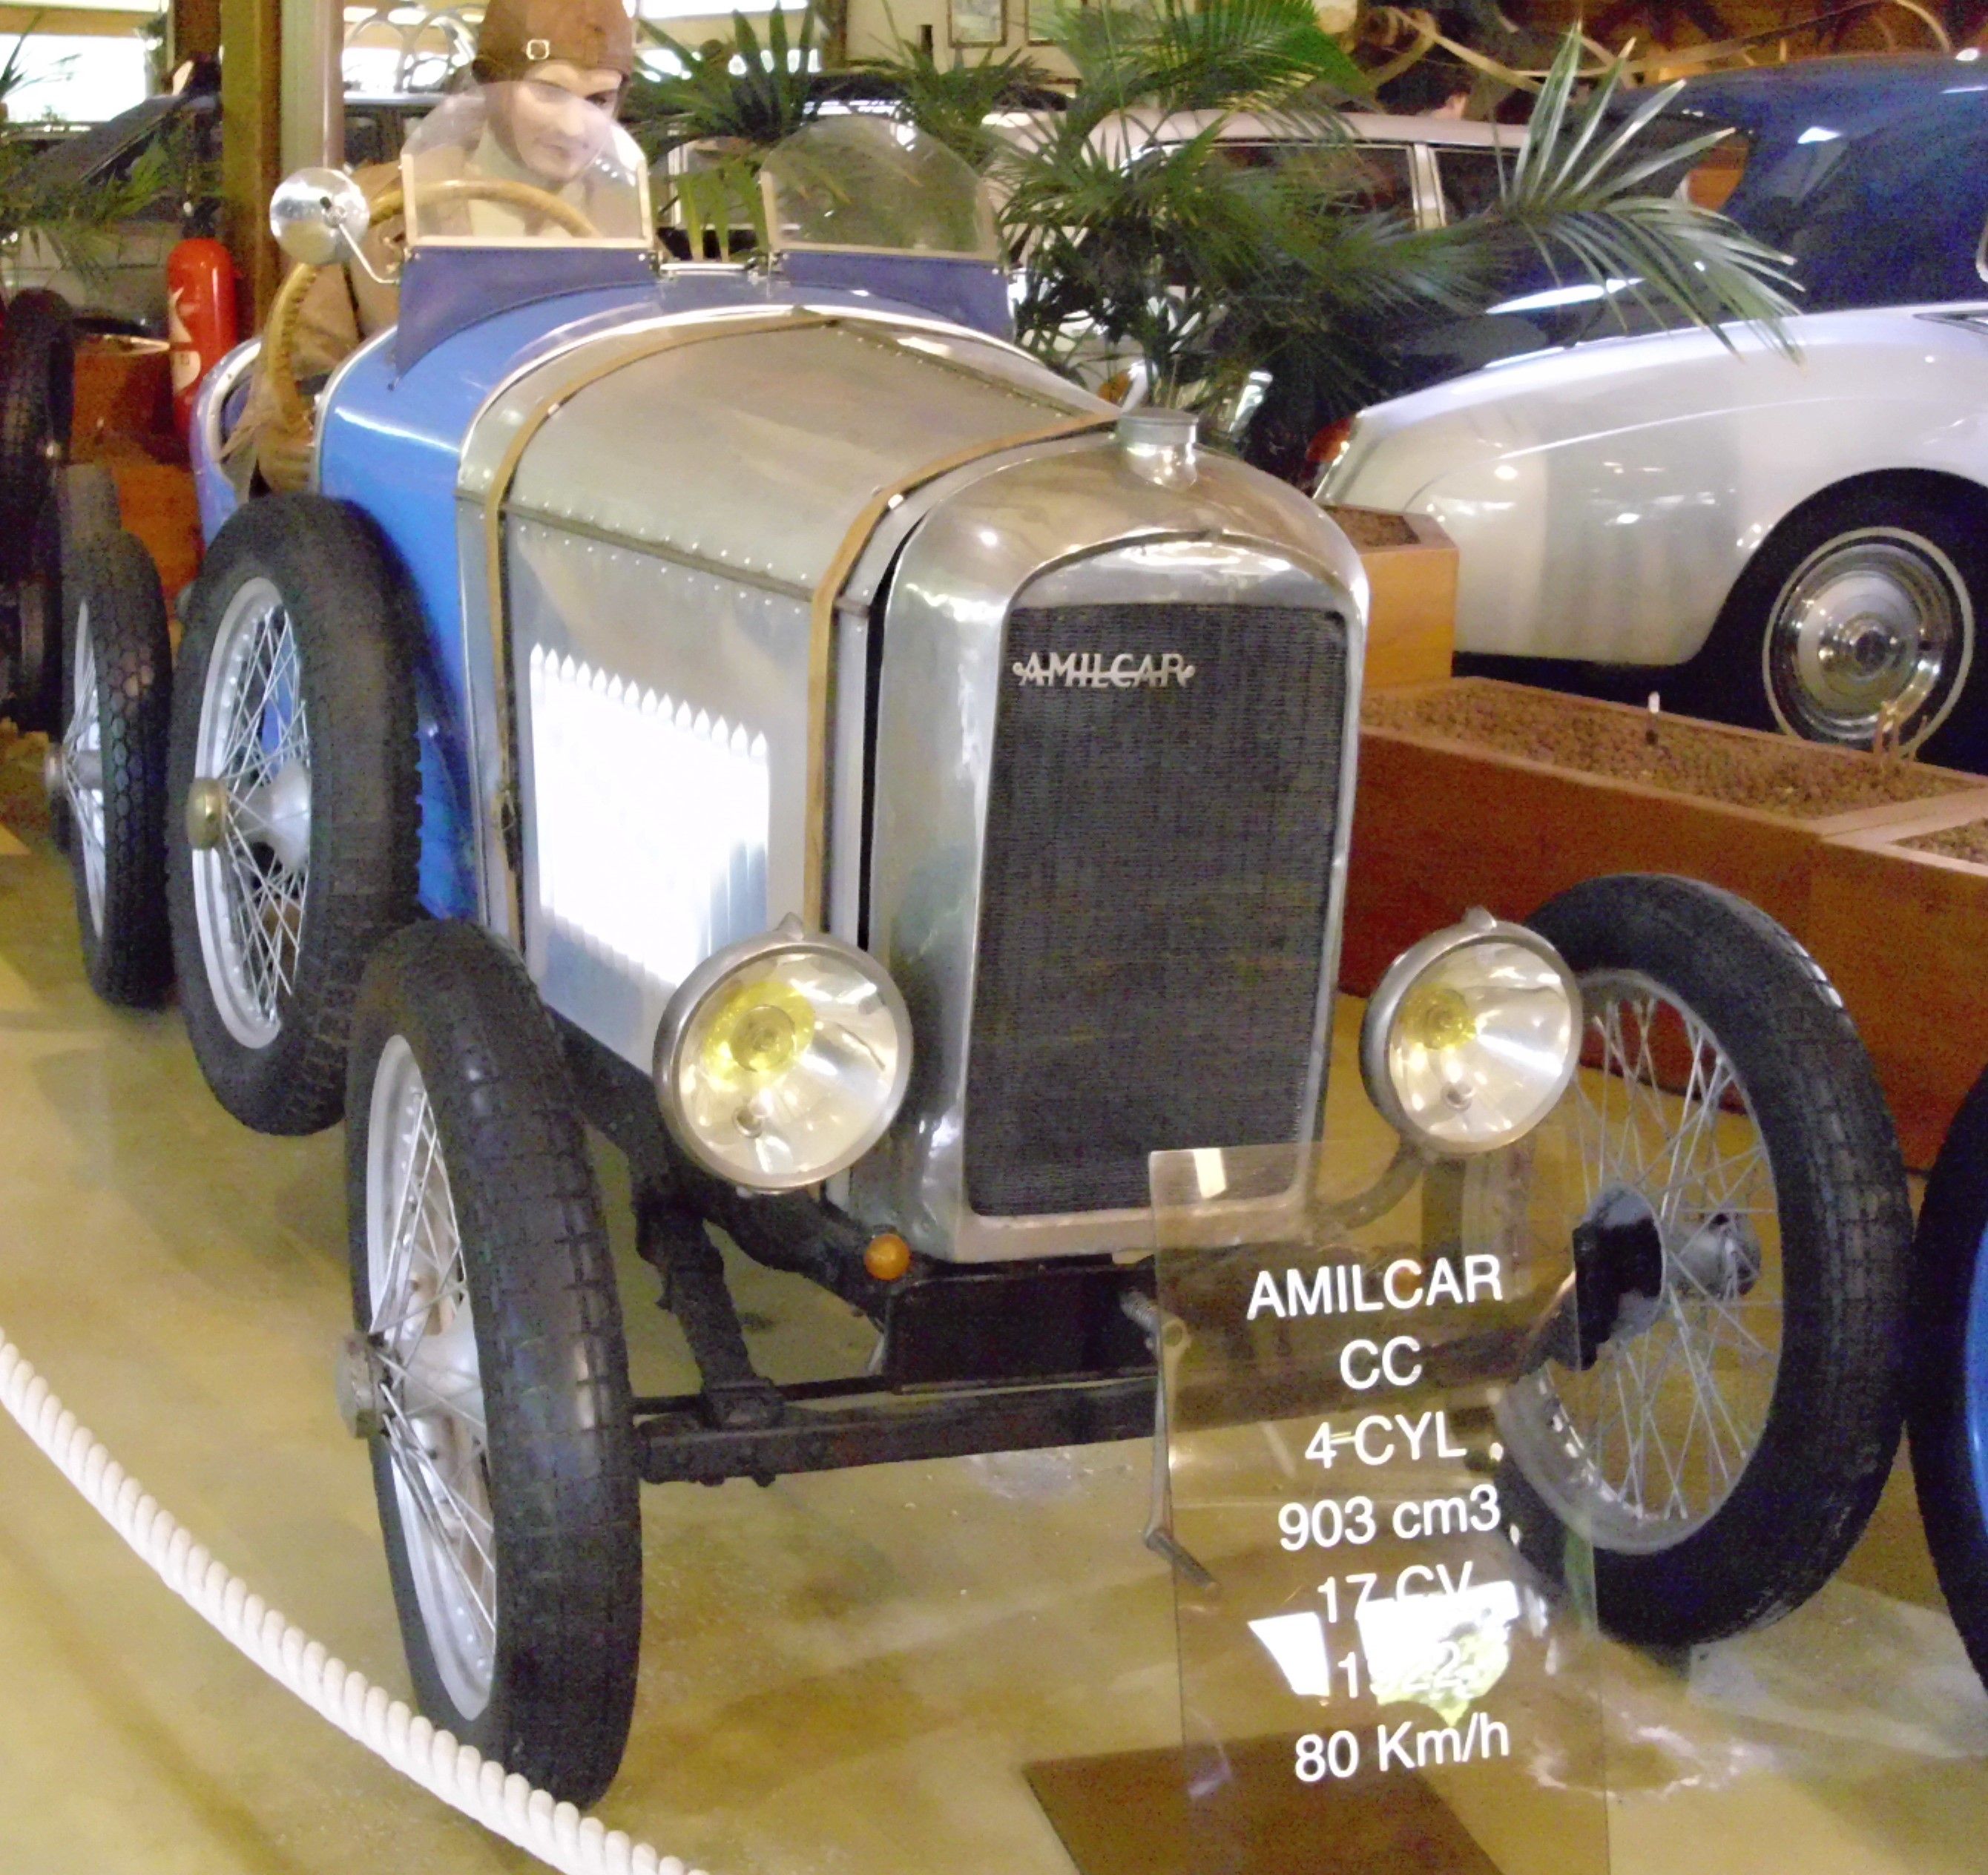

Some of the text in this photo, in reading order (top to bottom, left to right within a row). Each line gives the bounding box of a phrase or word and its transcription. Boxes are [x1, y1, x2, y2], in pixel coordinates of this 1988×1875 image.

[1013, 653, 1196, 688] AMILCAR
[1247, 1254, 1503, 1319] AMILCAR
[1340, 1336, 1422, 1389] CC
[1355, 1411, 1468, 1466] CYL
[1278, 1483, 1501, 1551] 903 cm3
[1317, 1574, 1378, 1623] 17
[1295, 1712, 1509, 1782] 80 Km/h
